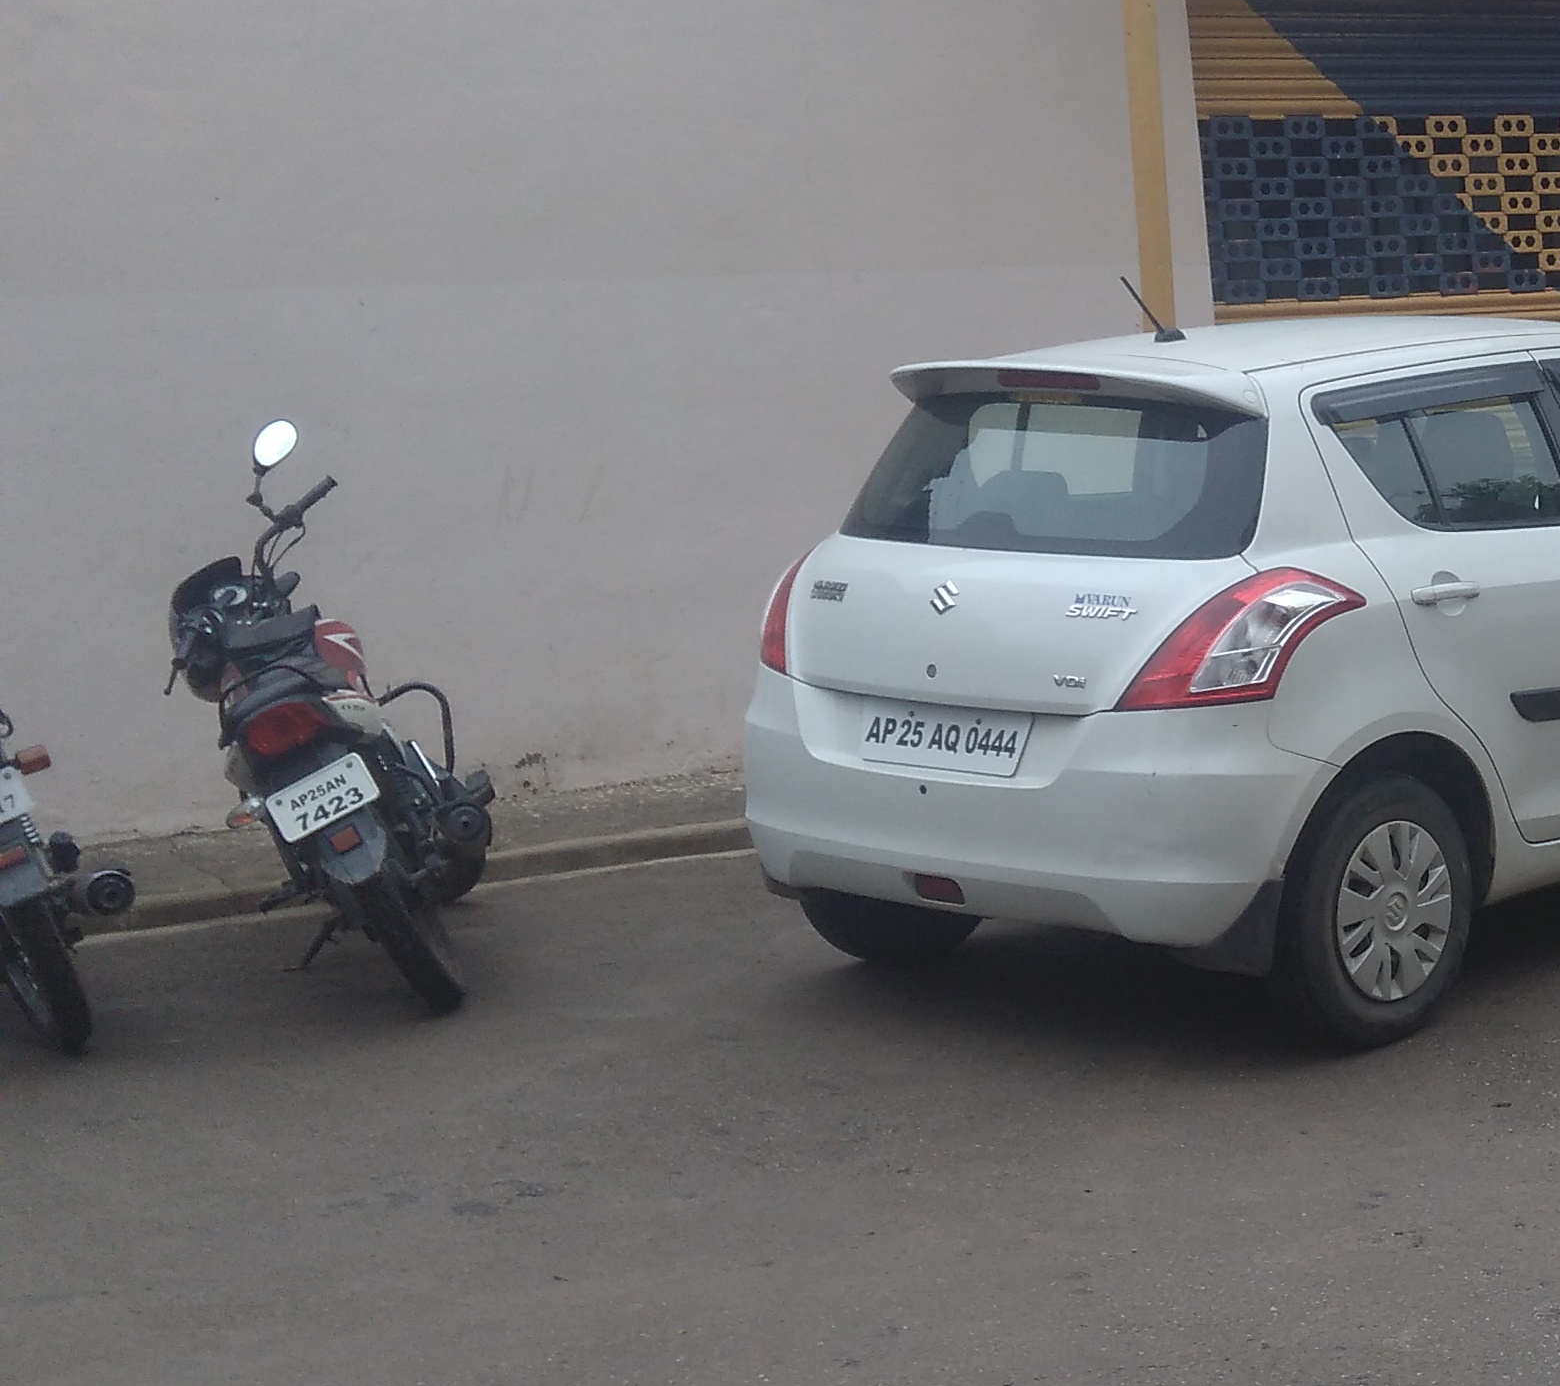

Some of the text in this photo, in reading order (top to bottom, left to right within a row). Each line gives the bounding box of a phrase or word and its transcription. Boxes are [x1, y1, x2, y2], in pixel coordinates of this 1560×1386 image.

[1065, 604, 1138, 621] SWIFT
[865, 716, 1018, 759] AP 25 AQ 0444
[290, 774, 347, 811] AP25AN
[295, 786, 365, 831] 7423
